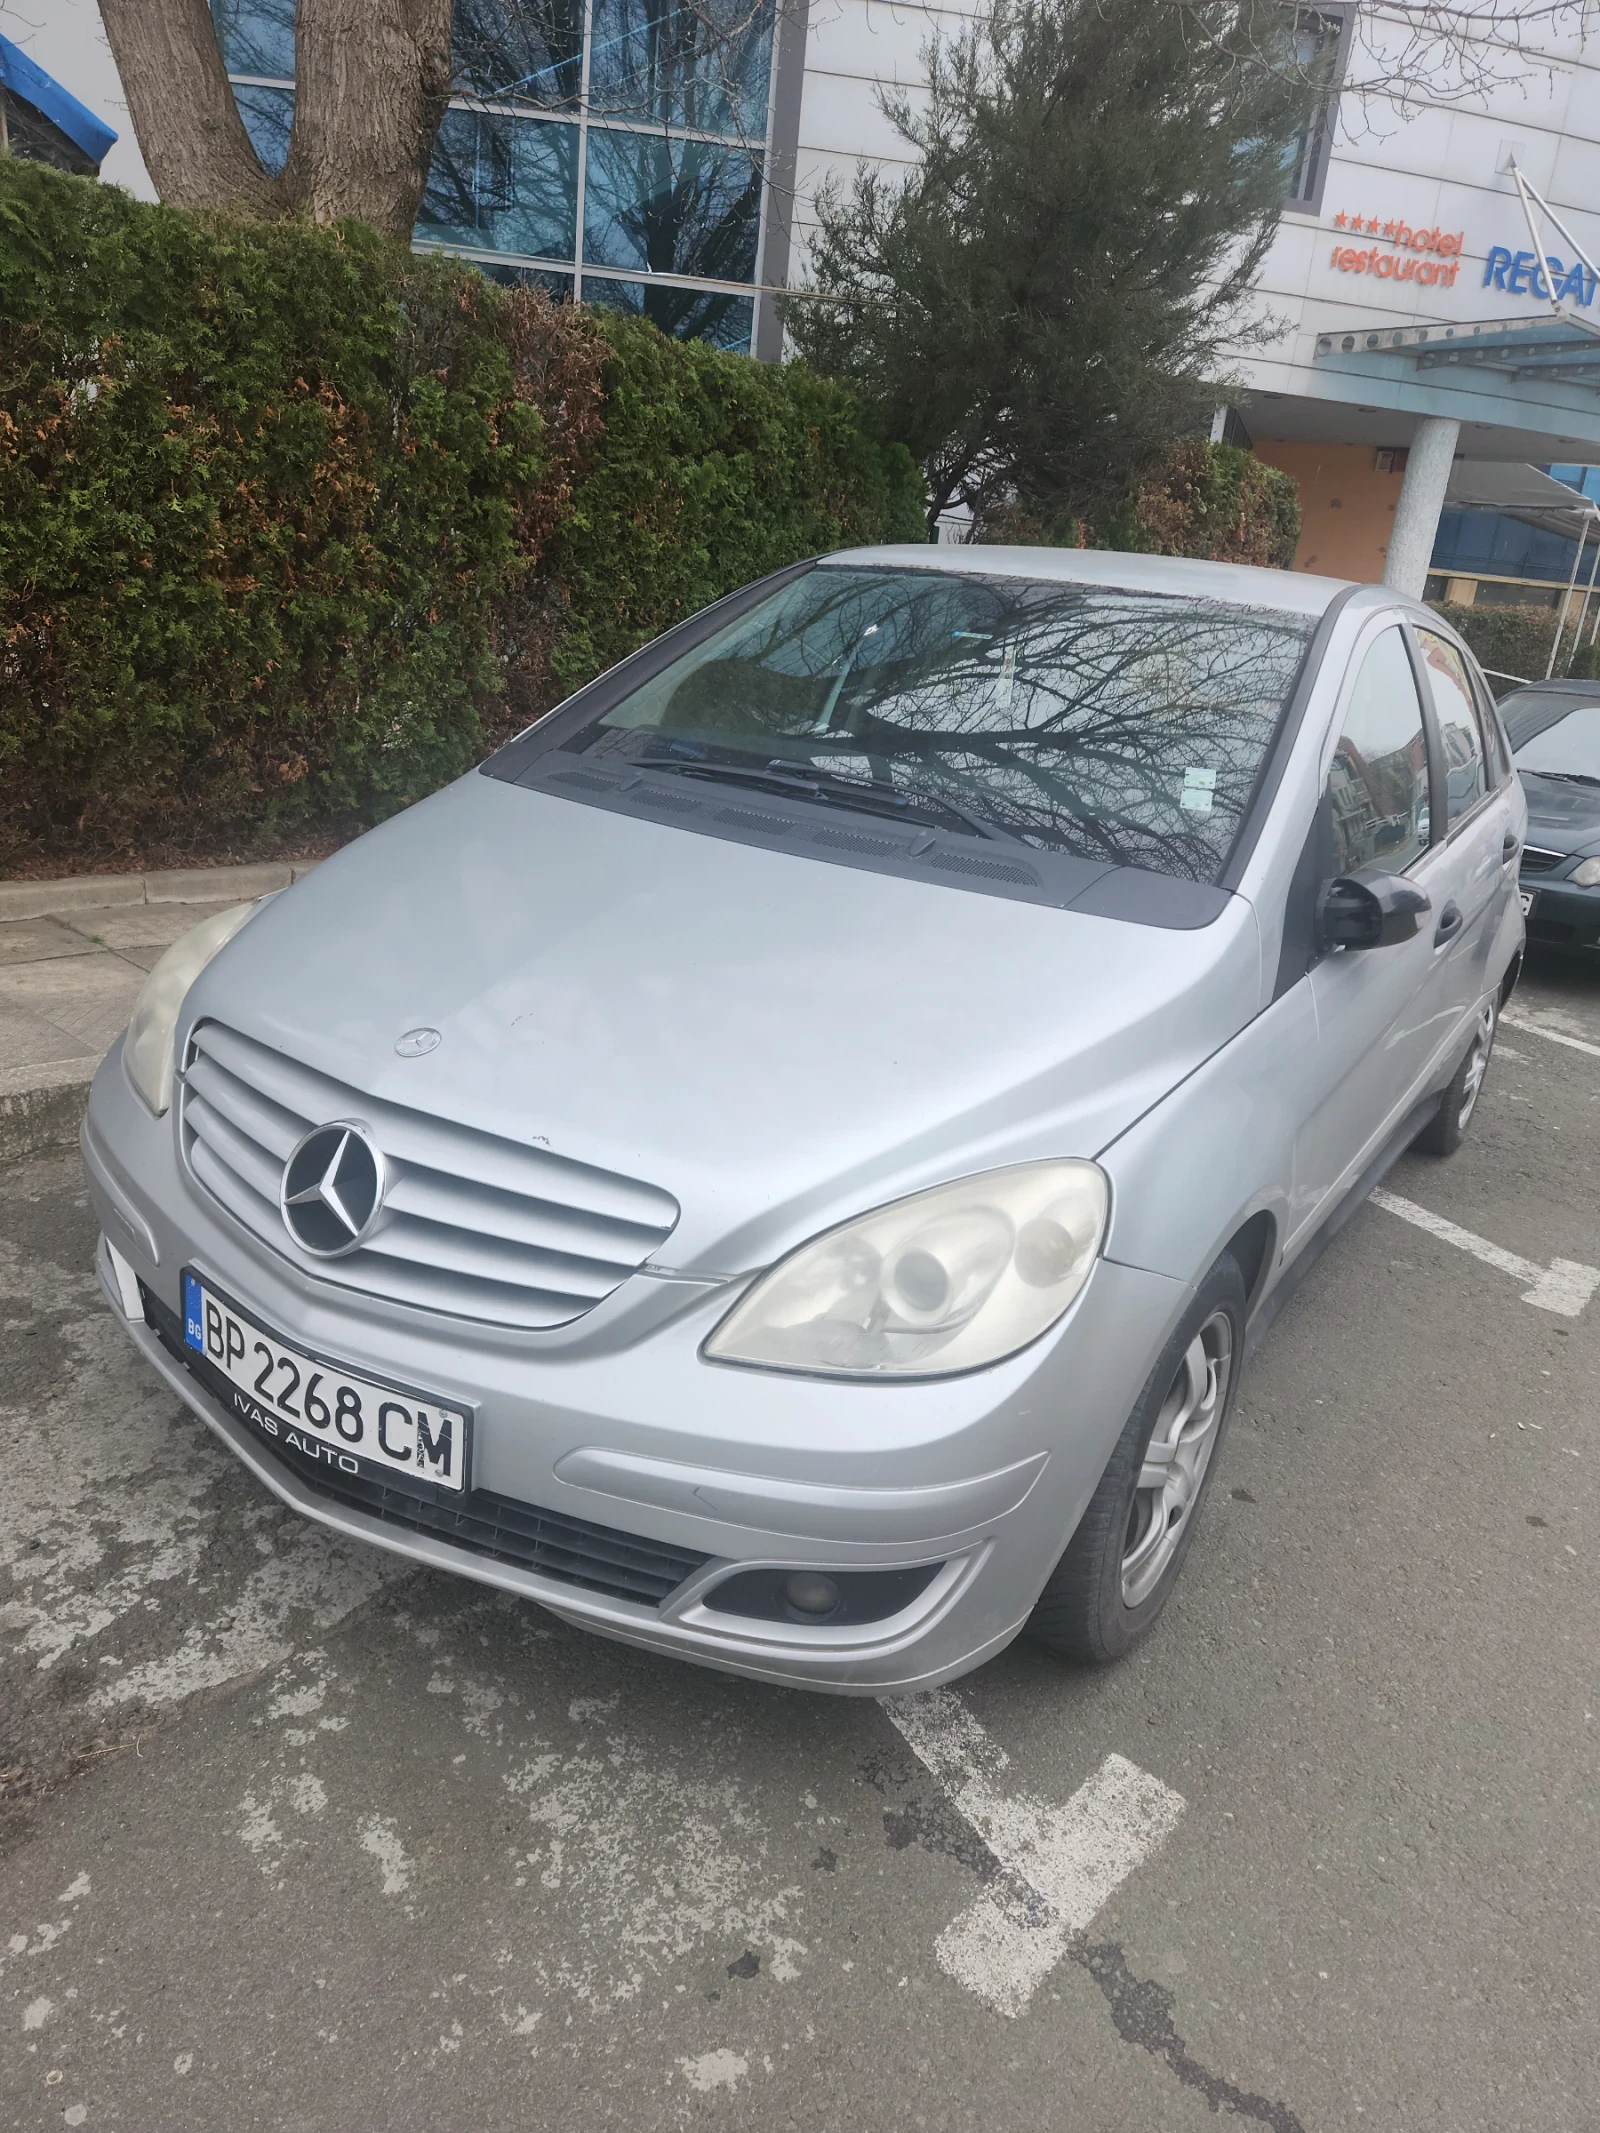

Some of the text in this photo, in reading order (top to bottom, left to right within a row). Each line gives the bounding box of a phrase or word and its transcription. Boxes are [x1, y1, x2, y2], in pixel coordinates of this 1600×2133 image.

[1395, 220, 1464, 257] hotel
[1331, 245, 1460, 287] restaurant
[188, 1318, 201, 1340] BG
[206, 1298, 453, 1478] BP 2268 CM
[234, 1393, 359, 1475] IVAS AUTO
